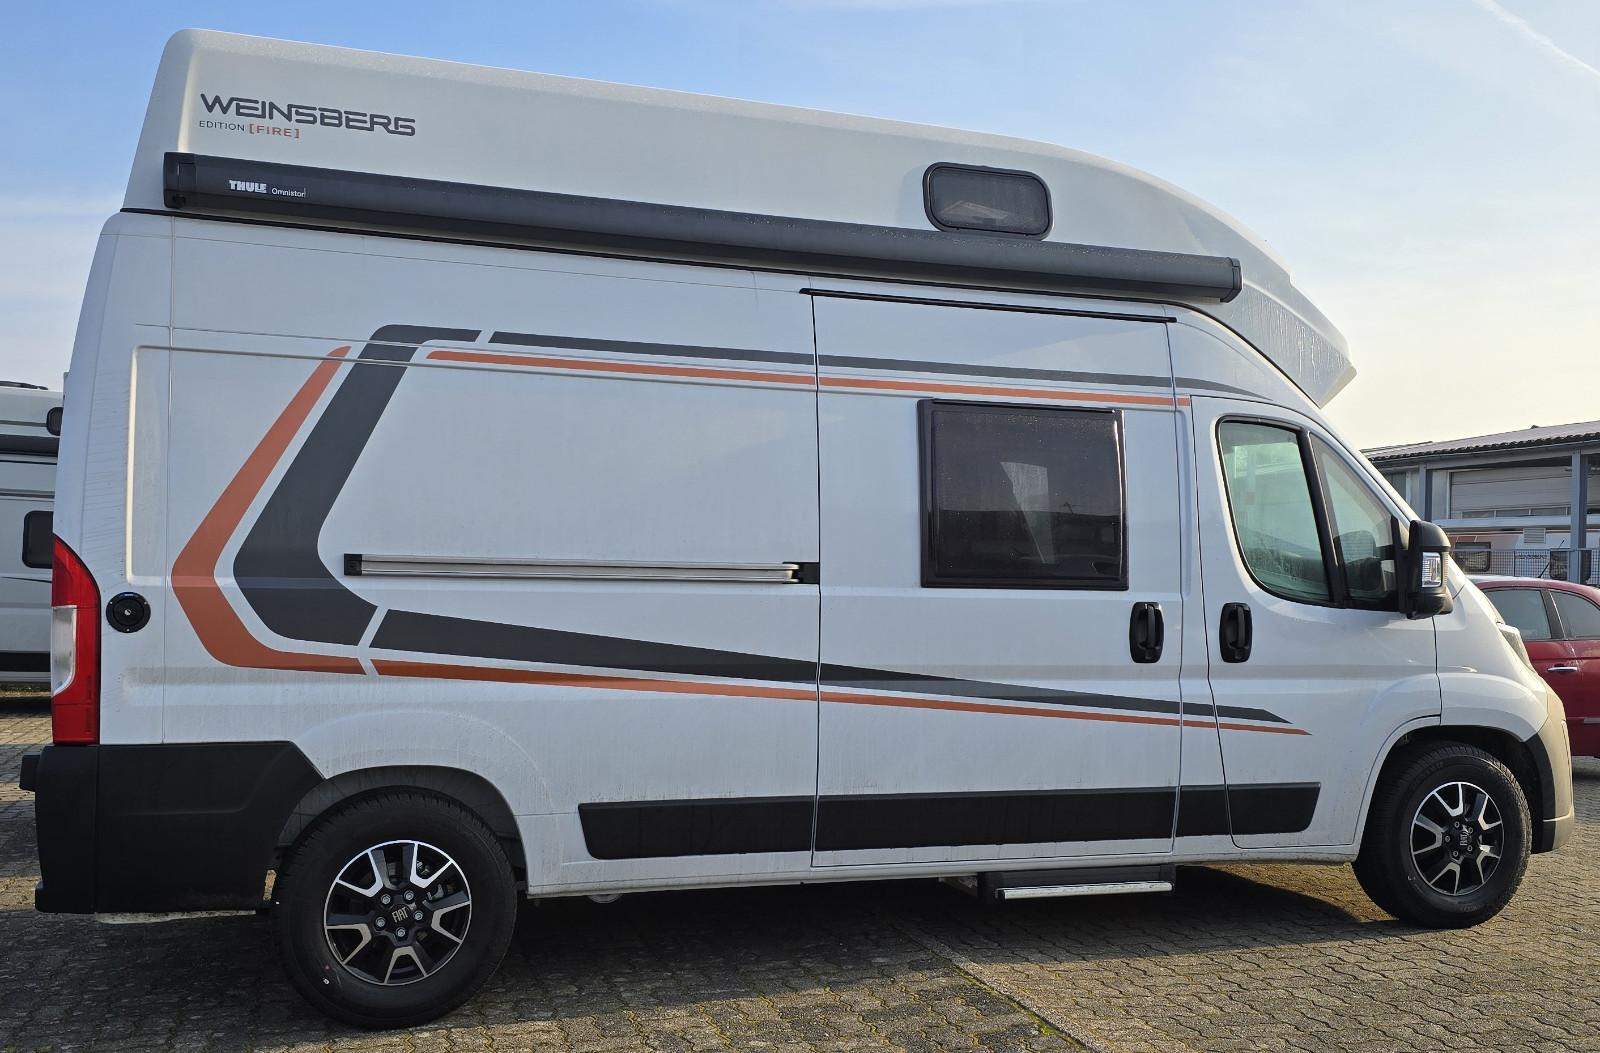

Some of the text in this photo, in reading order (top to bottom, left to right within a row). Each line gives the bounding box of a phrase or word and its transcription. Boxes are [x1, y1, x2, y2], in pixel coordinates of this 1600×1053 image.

[200, 93, 416, 137] WEINSBERG
[199, 120, 245, 132] EDITION
[228, 179, 305, 198] THULE Omnistor
[391, 906, 408, 923] FIAT
